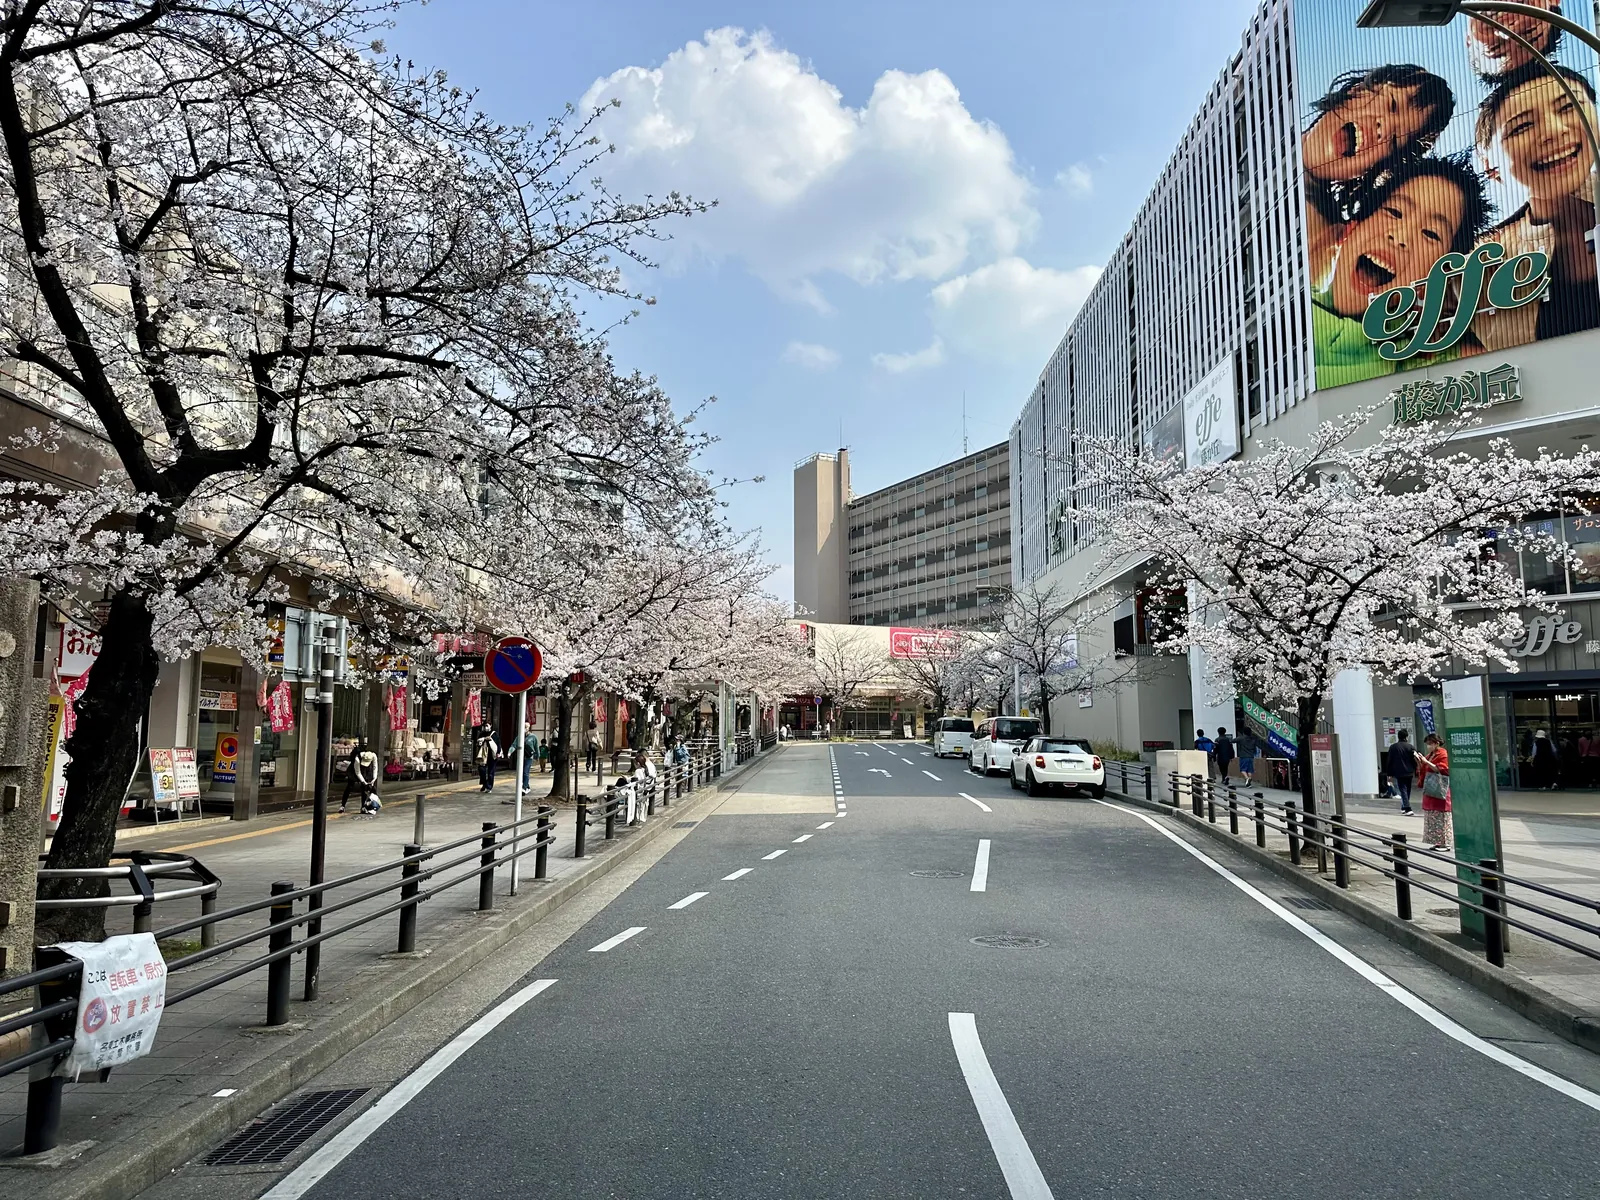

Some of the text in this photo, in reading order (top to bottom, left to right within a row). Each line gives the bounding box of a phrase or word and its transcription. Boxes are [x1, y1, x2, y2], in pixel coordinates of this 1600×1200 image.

[1362, 242, 1551, 360] effe
[1391, 362, 1523, 425] 藤が丘
[1195, 393, 1223, 446] effe
[1501, 615, 1583, 657] effe
[88, 960, 164, 991] ここは 自転車・原付
[110, 991, 164, 1025] 放置禁止
